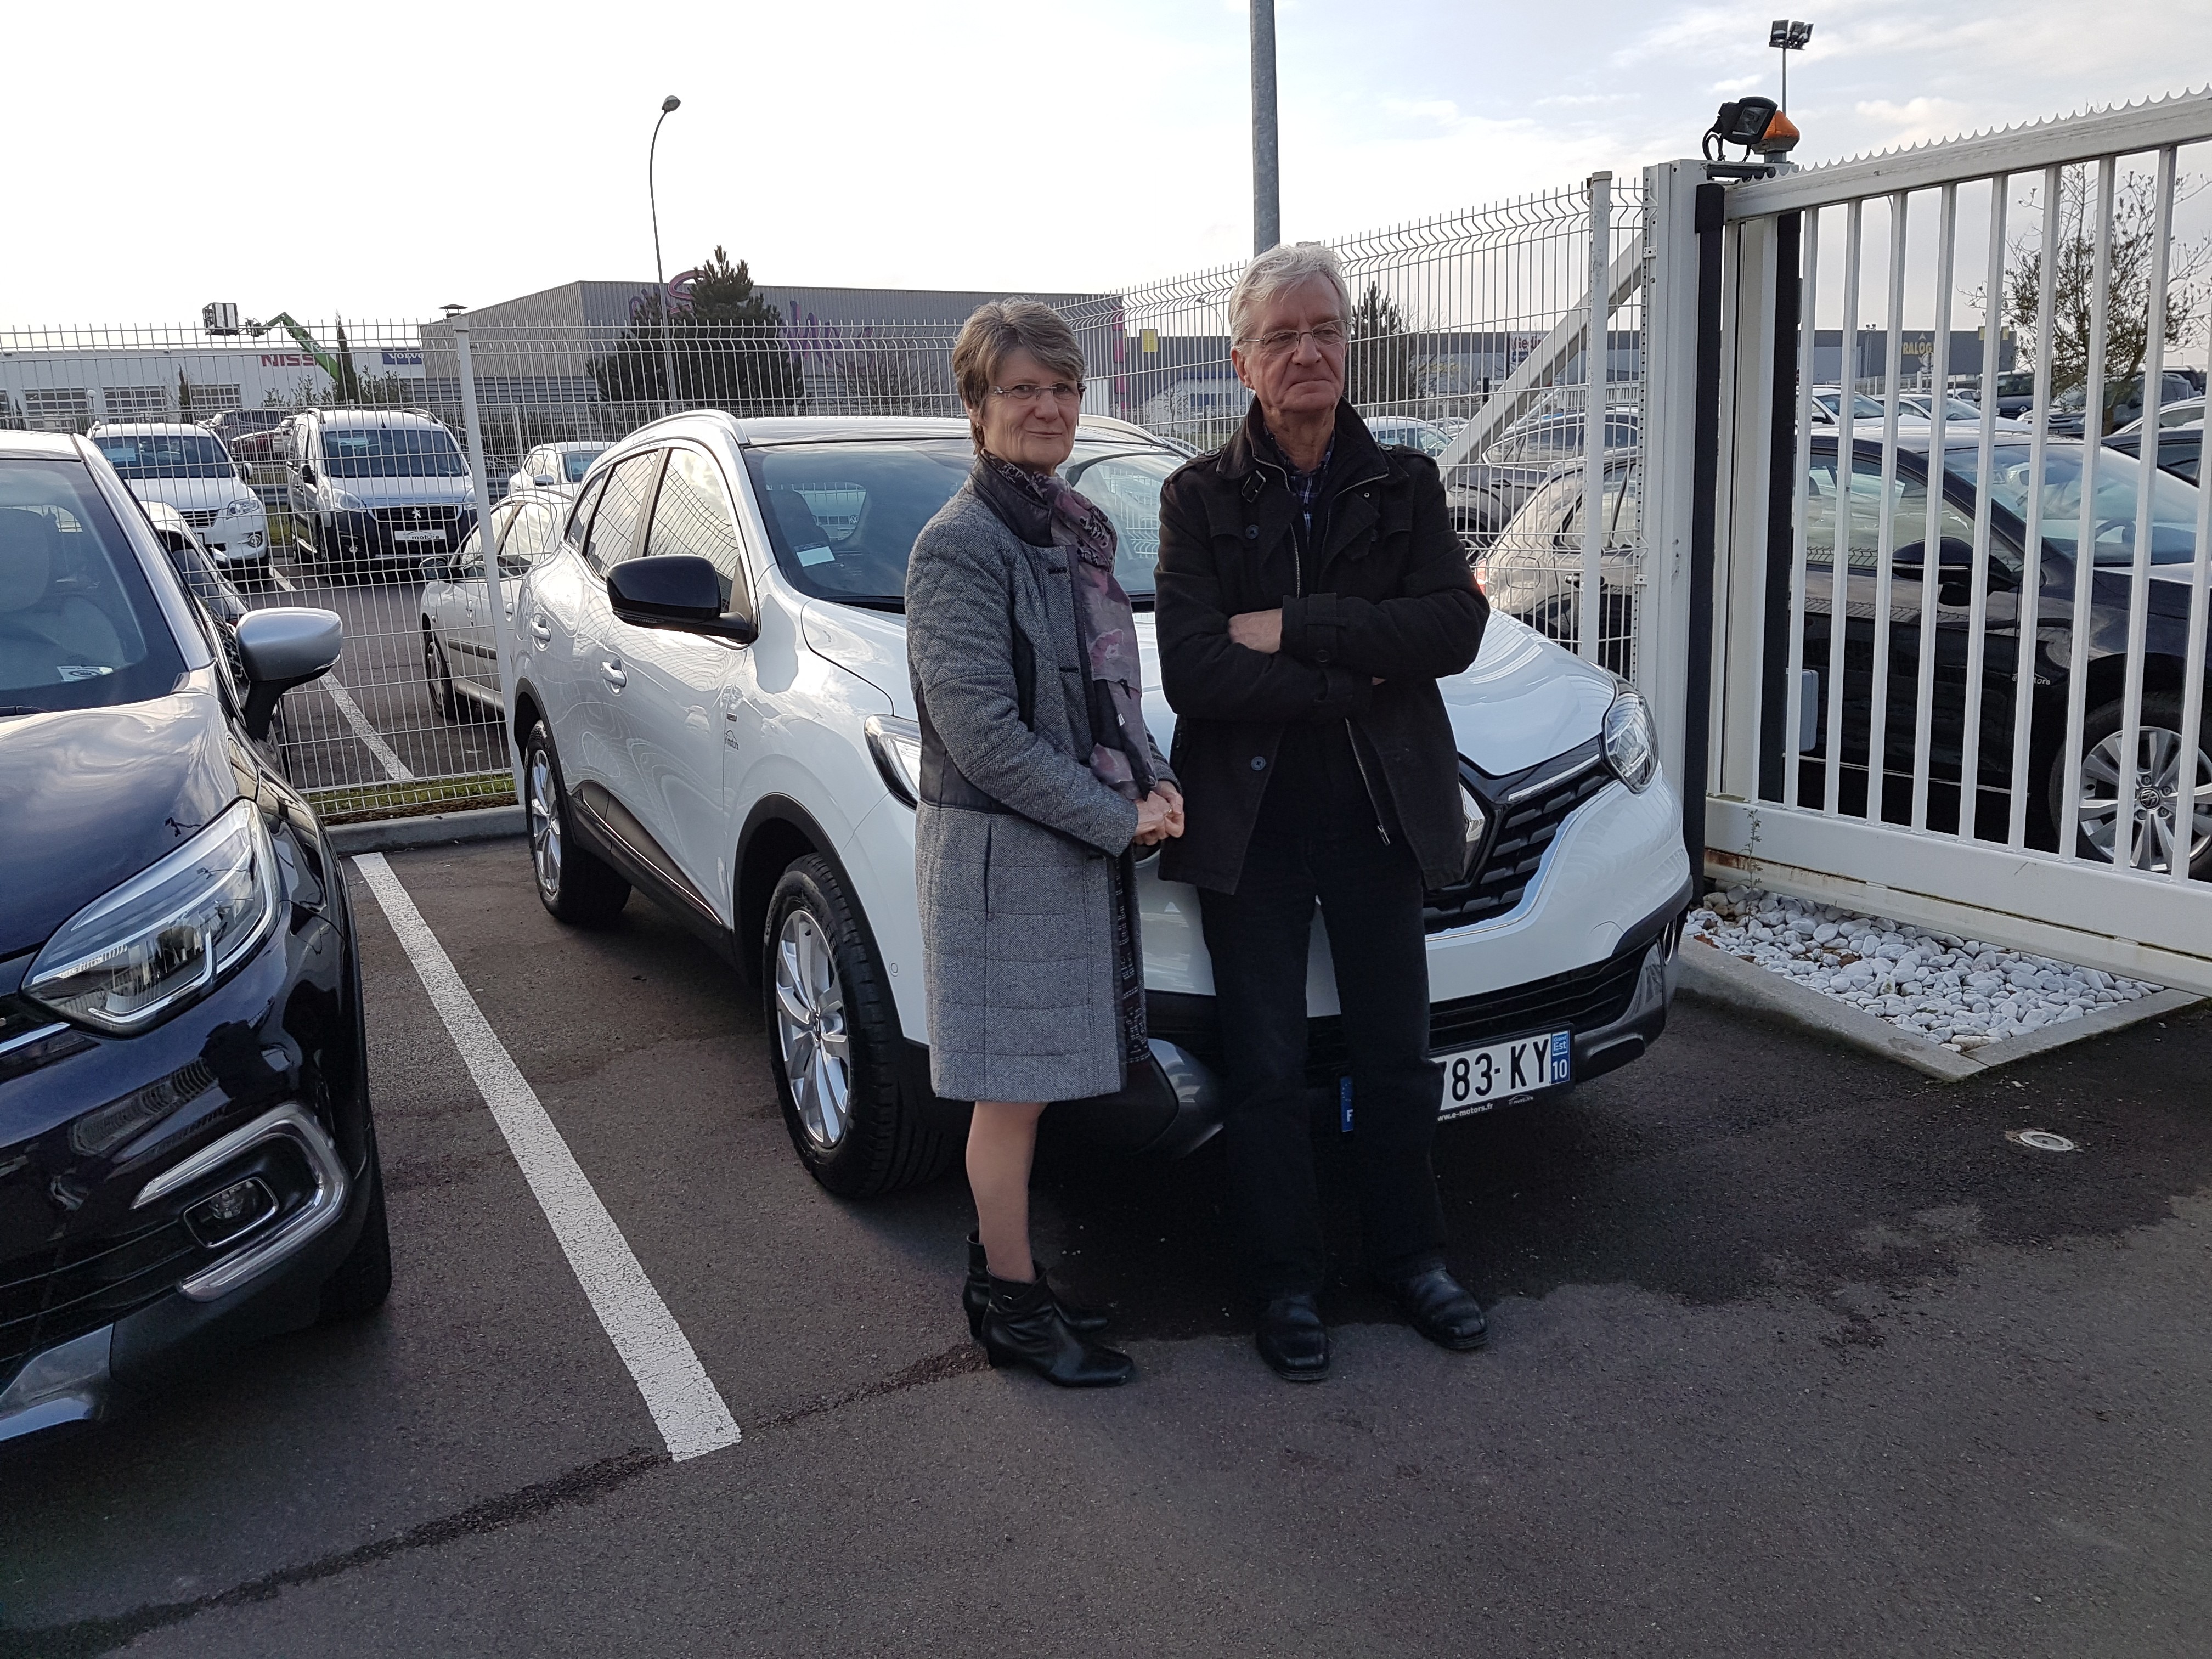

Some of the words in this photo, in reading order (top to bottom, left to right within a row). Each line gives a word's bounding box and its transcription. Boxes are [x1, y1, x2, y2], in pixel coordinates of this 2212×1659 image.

[261, 354, 319, 367] NISS
[1554, 1041, 1566, 1051] Est
[1553, 1059, 1567, 1080] 10
[1347, 1109, 1353, 1122] F
[1437, 1102, 1493, 1122] ww.e-motors.fr
